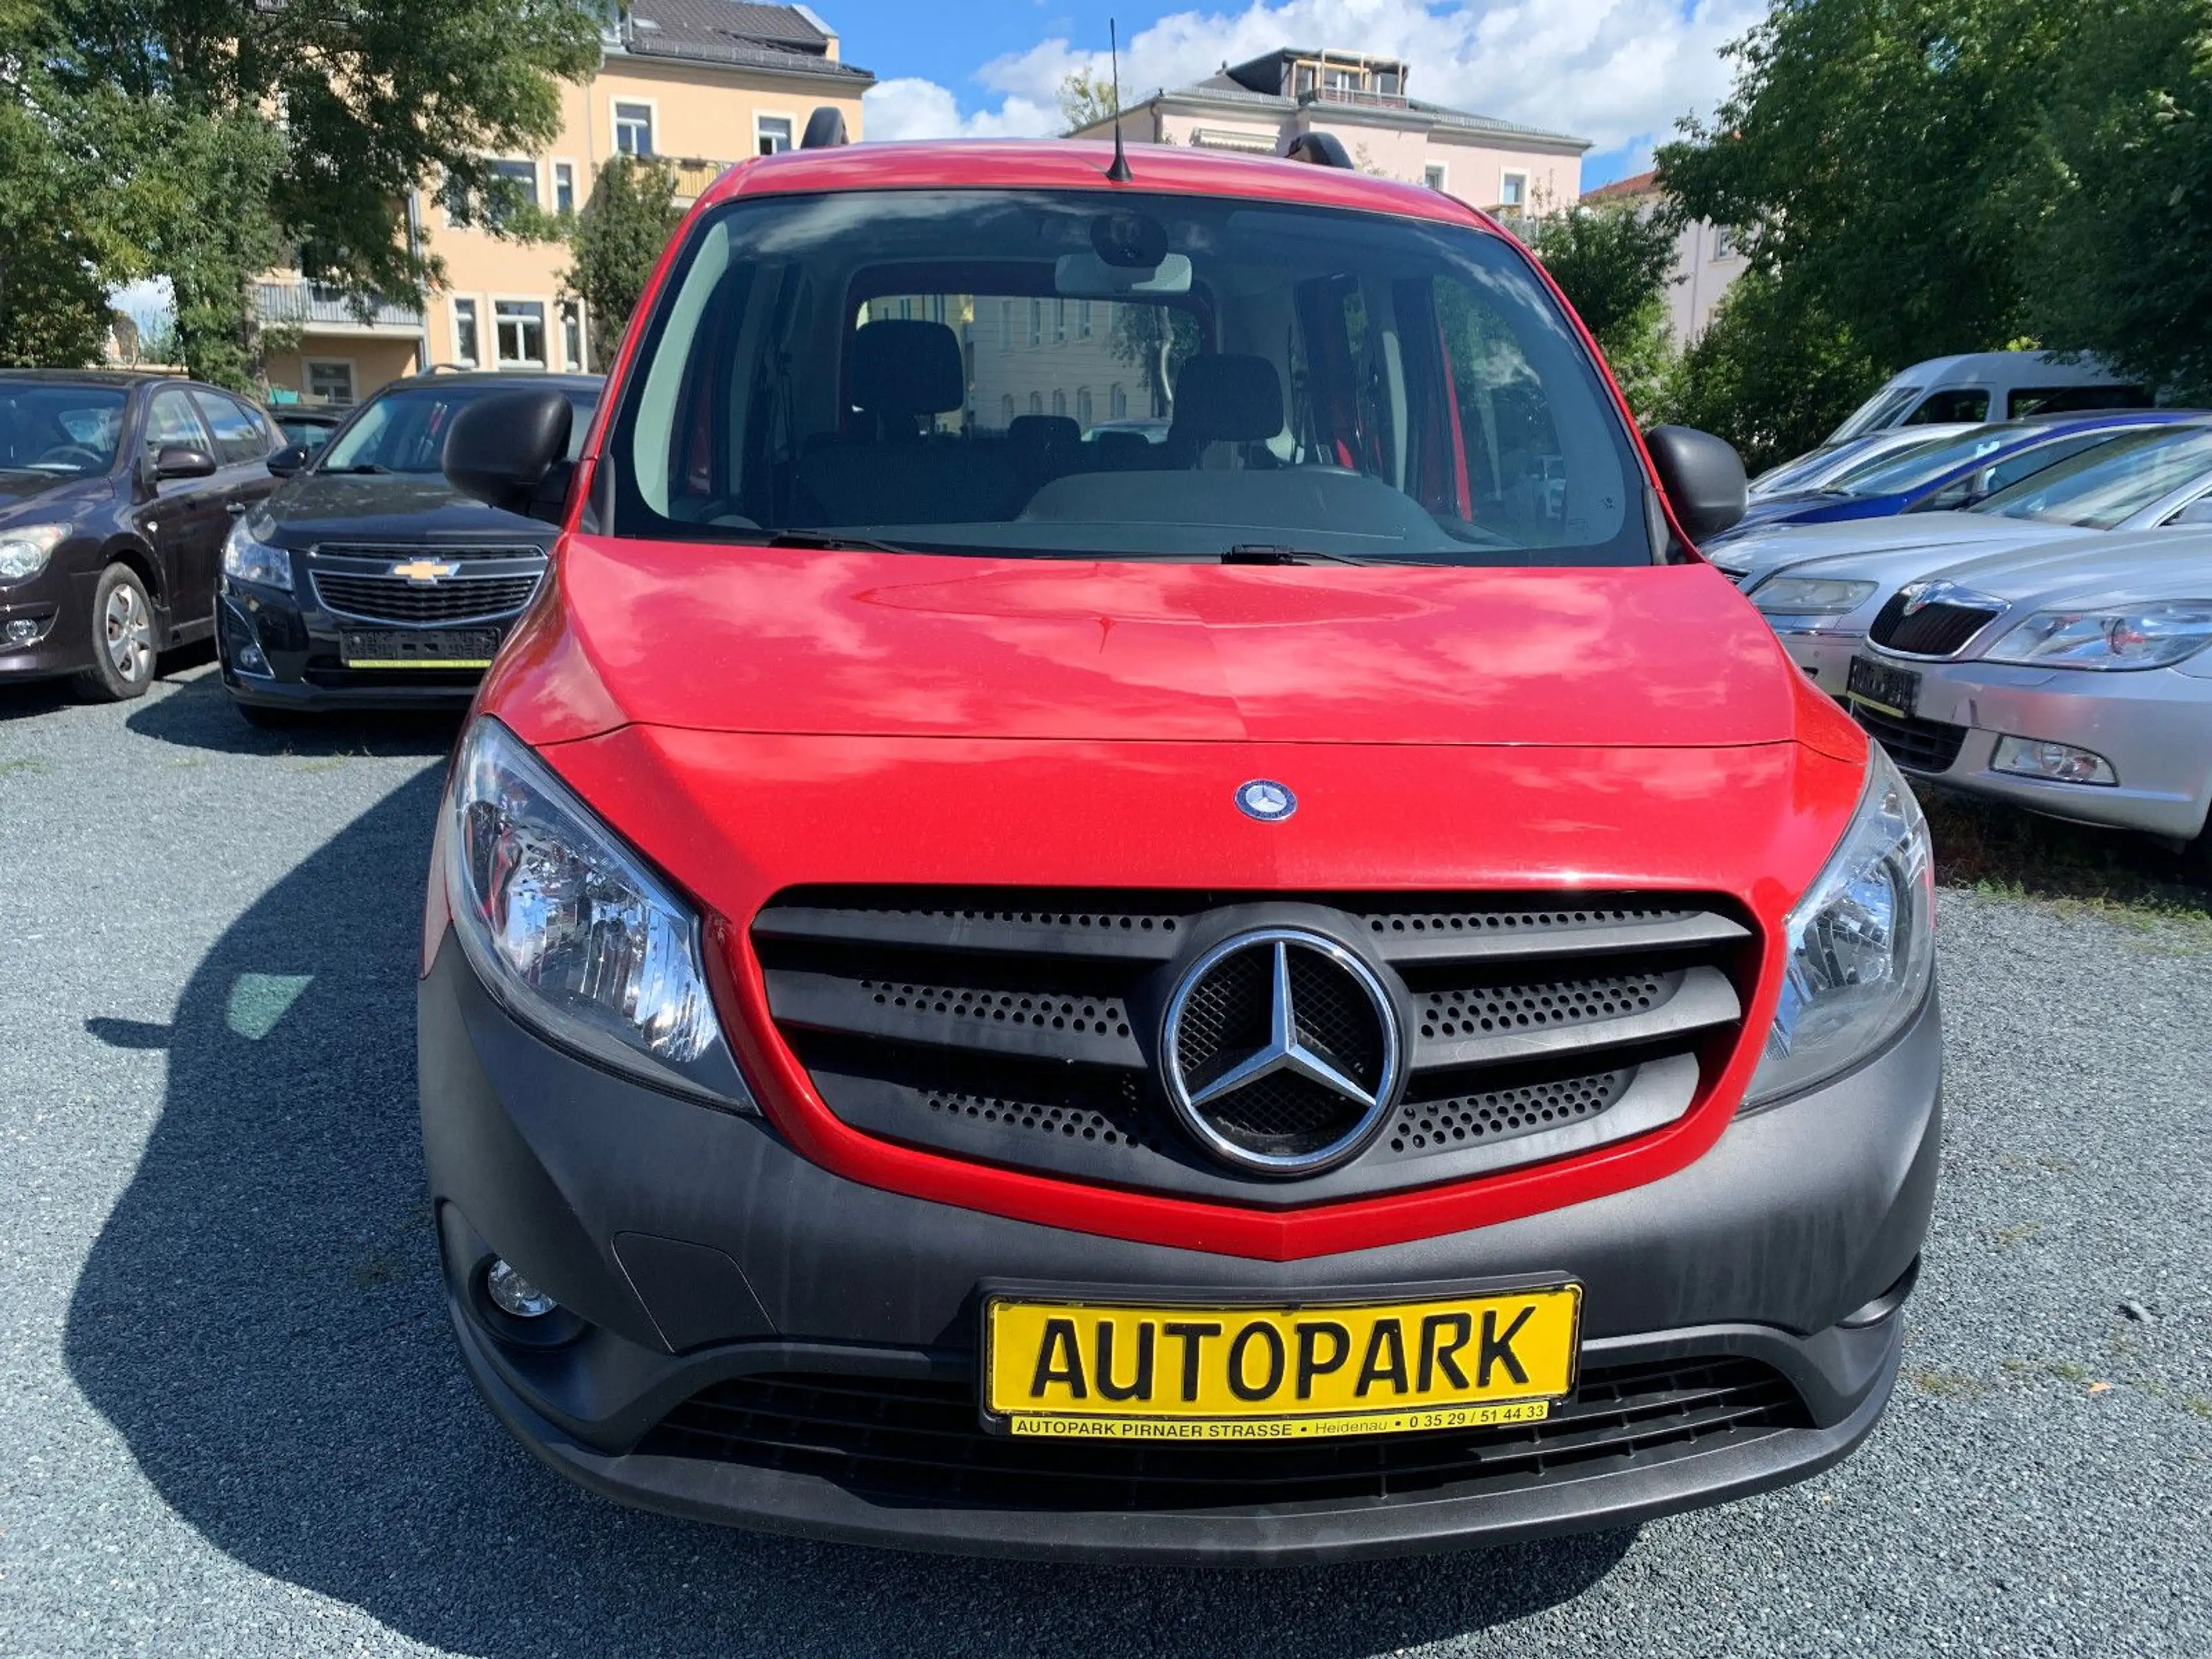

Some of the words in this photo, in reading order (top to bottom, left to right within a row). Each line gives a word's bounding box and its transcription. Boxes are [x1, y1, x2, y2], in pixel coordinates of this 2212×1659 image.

[1028, 1305, 1536, 1403] AUTOPARK
[1016, 1420, 1116, 1435] AUTOPARK
[1122, 1423, 1203, 1437] PIRNAER
[1209, 1424, 1293, 1437] STRASSE
[1315, 1421, 1388, 1434] Heidenau
